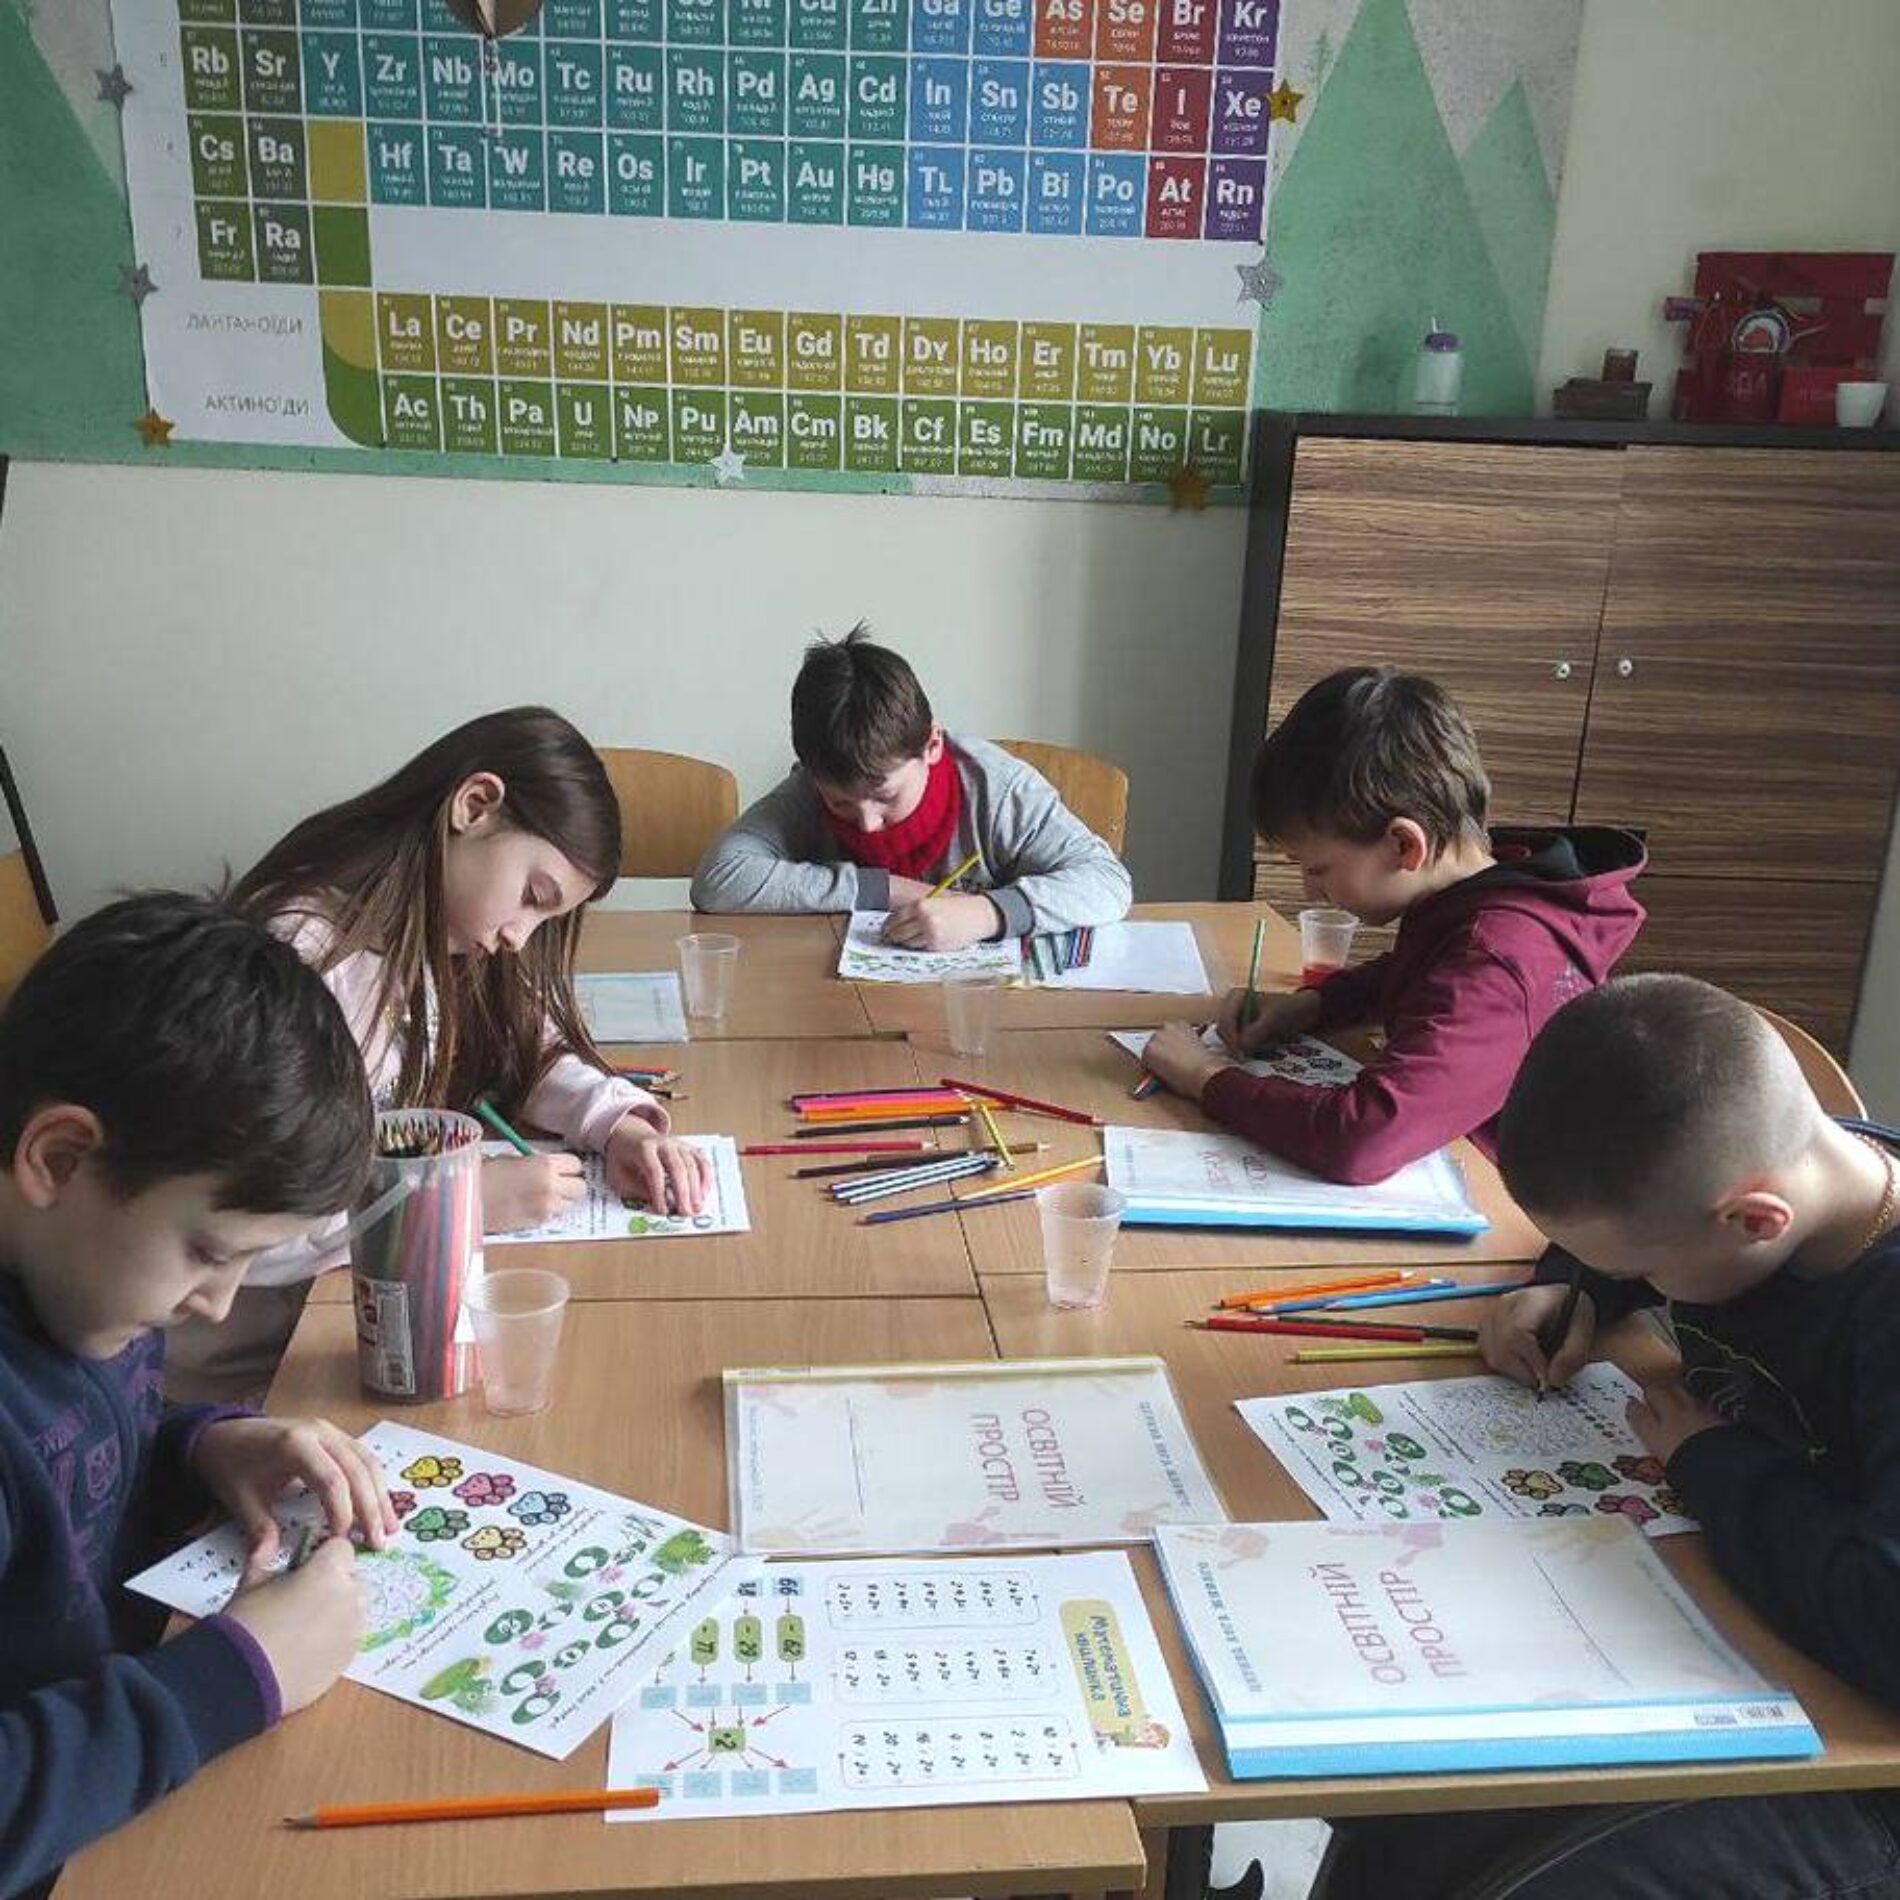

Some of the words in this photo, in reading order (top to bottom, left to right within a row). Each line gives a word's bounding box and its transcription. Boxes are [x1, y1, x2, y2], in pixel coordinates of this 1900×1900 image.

[985, 0, 1021, 19] Ge
[1046, 0, 1083, 21] As
[1108, 0, 1144, 23] Se
[1174, 0, 1205, 26] Br
[1233, 2, 1268, 28] Kr
[191, 47, 229, 74] Rb
[255, 50, 286, 77] Sr
[321, 52, 340, 79] Y
[376, 55, 407, 82] Zr
[433, 57, 472, 84] Nb
[491, 61, 534, 87] Mo
[556, 62, 590, 90] Tc
[616, 64, 653, 92] Ru
[676, 68, 714, 96] Rh
[738, 71, 774, 99] Pd
[798, 73, 836, 103] Ag
[858, 75, 897, 103] Cd
[926, 78, 951, 105] In
[981, 80, 1018, 108] Sn
[1043, 83, 1079, 111] Sb
[1103, 85, 1138, 113] Te
[1225, 90, 1262, 118] Xe
[200, 135, 234, 161] Cs
[258, 136, 294, 163] Ba
[380, 142, 413, 169] Hf
[438, 145, 472, 172] Ta
[502, 148, 529, 175] W
[557, 150, 594, 178] Re
[617, 153, 654, 180] Os
[686, 156, 707, 183] Ir
[740, 159, 772, 186] Pt
[796, 162, 834, 189] Au
[857, 164, 895, 193] Hg
[978, 169, 1015, 197] Pb
[1042, 171, 1070, 199] Bi
[1097, 174, 1133, 201] Po
[1159, 176, 1192, 203] At
[1216, 178, 1254, 205] Rn
[210, 220, 237, 245] Fr
[265, 222, 301, 249] Ra
[389, 311, 421, 337] La
[446, 314, 482, 340] Ce
[507, 316, 537, 342] Pr
[562, 319, 599, 346] Nd
[616, 323, 661, 349] Pm
[676, 325, 719, 352] Sm
[738, 328, 772, 354] Eu
[796, 330, 832, 357] Gd
[970, 338, 1008, 364] Ho
[1033, 341, 1063, 366] Er
[1084, 343, 1126, 368] Tm
[1146, 345, 1180, 370] Yb
[1205, 347, 1239, 372] Lu
[393, 392, 429, 418] Ac
[449, 395, 486, 420] Th
[509, 398, 543, 424] Pa
[574, 401, 592, 426] U
[681, 406, 716, 432] Pu
[733, 409, 778, 434] Am
[791, 412, 835, 437] Cm
[853, 414, 889, 440] Bk
[914, 416, 945, 442] Cf
[970, 418, 1002, 444] Es
[1022, 422, 1064, 447] Fm
[1080, 424, 1123, 449] Md
[1140, 426, 1177, 451] No
[1202, 428, 1229, 452] Lr
[971, 1412, 1020, 1505] ПРОСТІР
[1020, 1406, 1080, 1511] ОСВІТНІЙ
[779, 1577, 799, 1597] 66
[1314, 1561, 1407, 1687] ОСВІТНІЙ
[1379, 1568, 1468, 1679] ПРОСТІР
